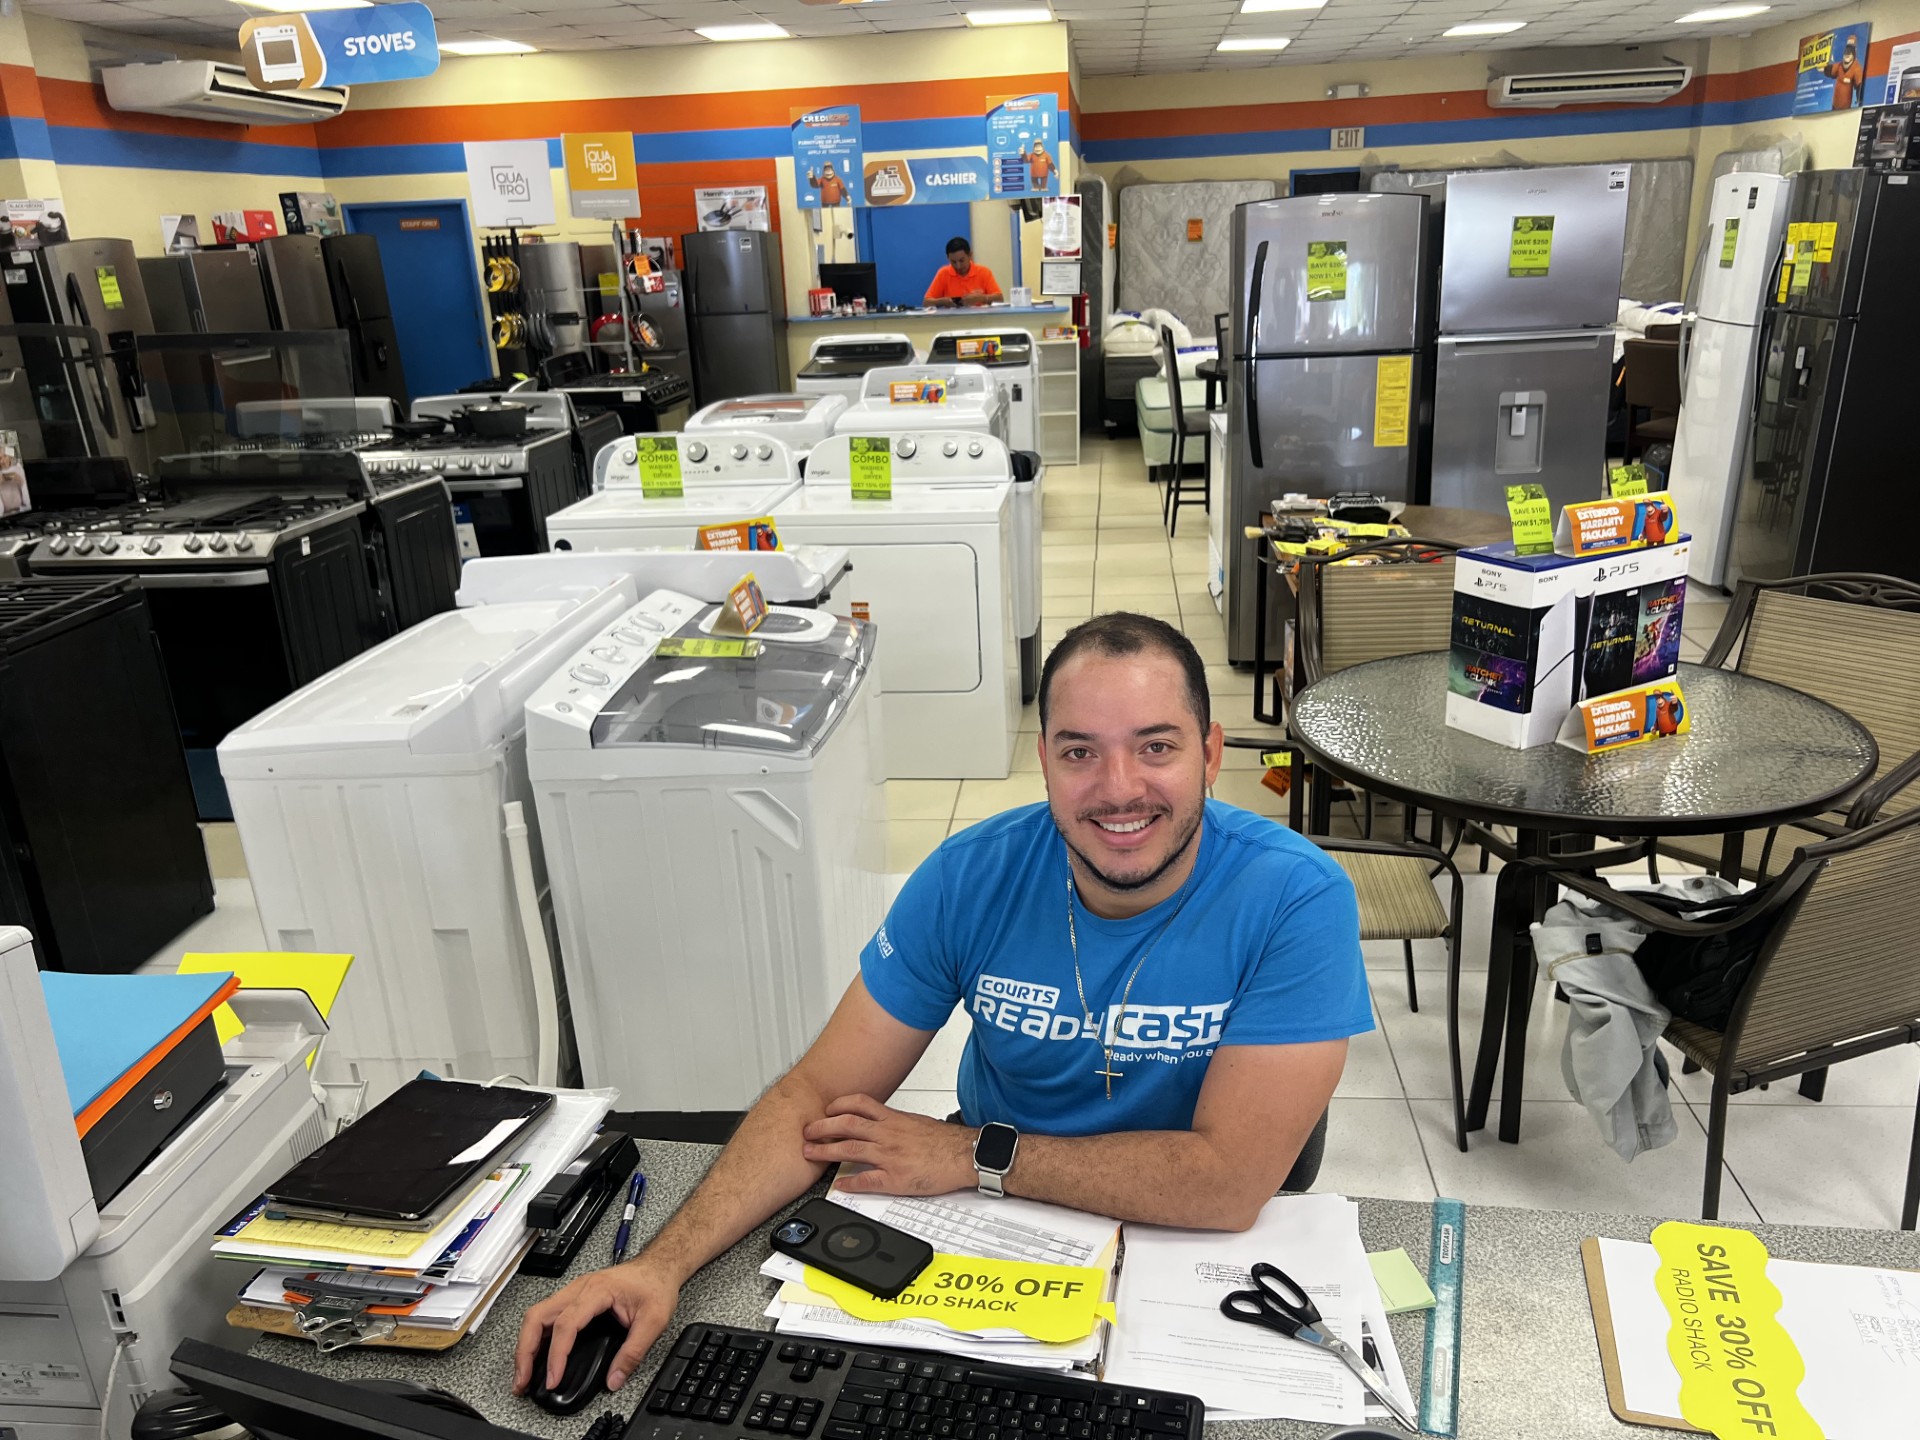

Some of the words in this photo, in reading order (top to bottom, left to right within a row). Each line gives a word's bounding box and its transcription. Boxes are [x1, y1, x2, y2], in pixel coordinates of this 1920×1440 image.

[343, 30, 416, 56] STOVES
[1816, 37, 1833, 51] CREDIT
[1338, 129, 1360, 148] EXIT
[925, 172, 977, 186] CASHIER
[640, 454, 677, 463] COMBO
[852, 455, 889, 464] COMBO
[1616, 489, 1631, 497] SAVE
[1632, 487, 1645, 495] $100
[1514, 507, 1530, 515] SAVE
[1531, 506, 1547, 514] $100
[1576, 506, 1620, 520] EXTENDED
[1580, 515, 1625, 530] WARRANTY
[706, 528, 738, 540] EXTENDED
[1580, 527, 1618, 541] PACKAGE
[709, 536, 742, 548] WARRANTY
[1481, 568, 1502, 578] SONY
[1609, 562, 1640, 577] PS5
[1484, 580, 1507, 592] PS5
[1538, 574, 1559, 584] SONY
[1647, 592, 1680, 607] RATCHET
[1650, 603, 1675, 614] CLANK
[1461, 616, 1516, 637] RETURNAL
[1590, 635, 1634, 650] RETURNAL
[1465, 664, 1505, 680] RATCHET
[1469, 672, 1497, 687] CLANK
[1590, 701, 1632, 716] EXTENDED
[1593, 710, 1636, 727] WARRANTY
[1594, 721, 1631, 738] PACKAGE
[981, 978, 1057, 1004] COURTS
[1145, 1050, 1178, 1065] when
[1181, 1050, 1204, 1062] you
[1697, 1243, 1740, 1304] SAVE
[934, 1272, 1004, 1294] 30%
[1014, 1278, 1084, 1299] OFF
[1672, 1267, 1699, 1315] RADIO
[942, 1296, 1020, 1312] SHACK
[1683, 1317, 1714, 1372] SHACK
[1715, 1313, 1757, 1370] 30%
[1435, 1352, 1444, 1391] TROPICASH
[1004, 1398, 1011, 1406] N
[1732, 1378, 1777, 1437] OFF
[1106, 1432, 1112, 1440] S
